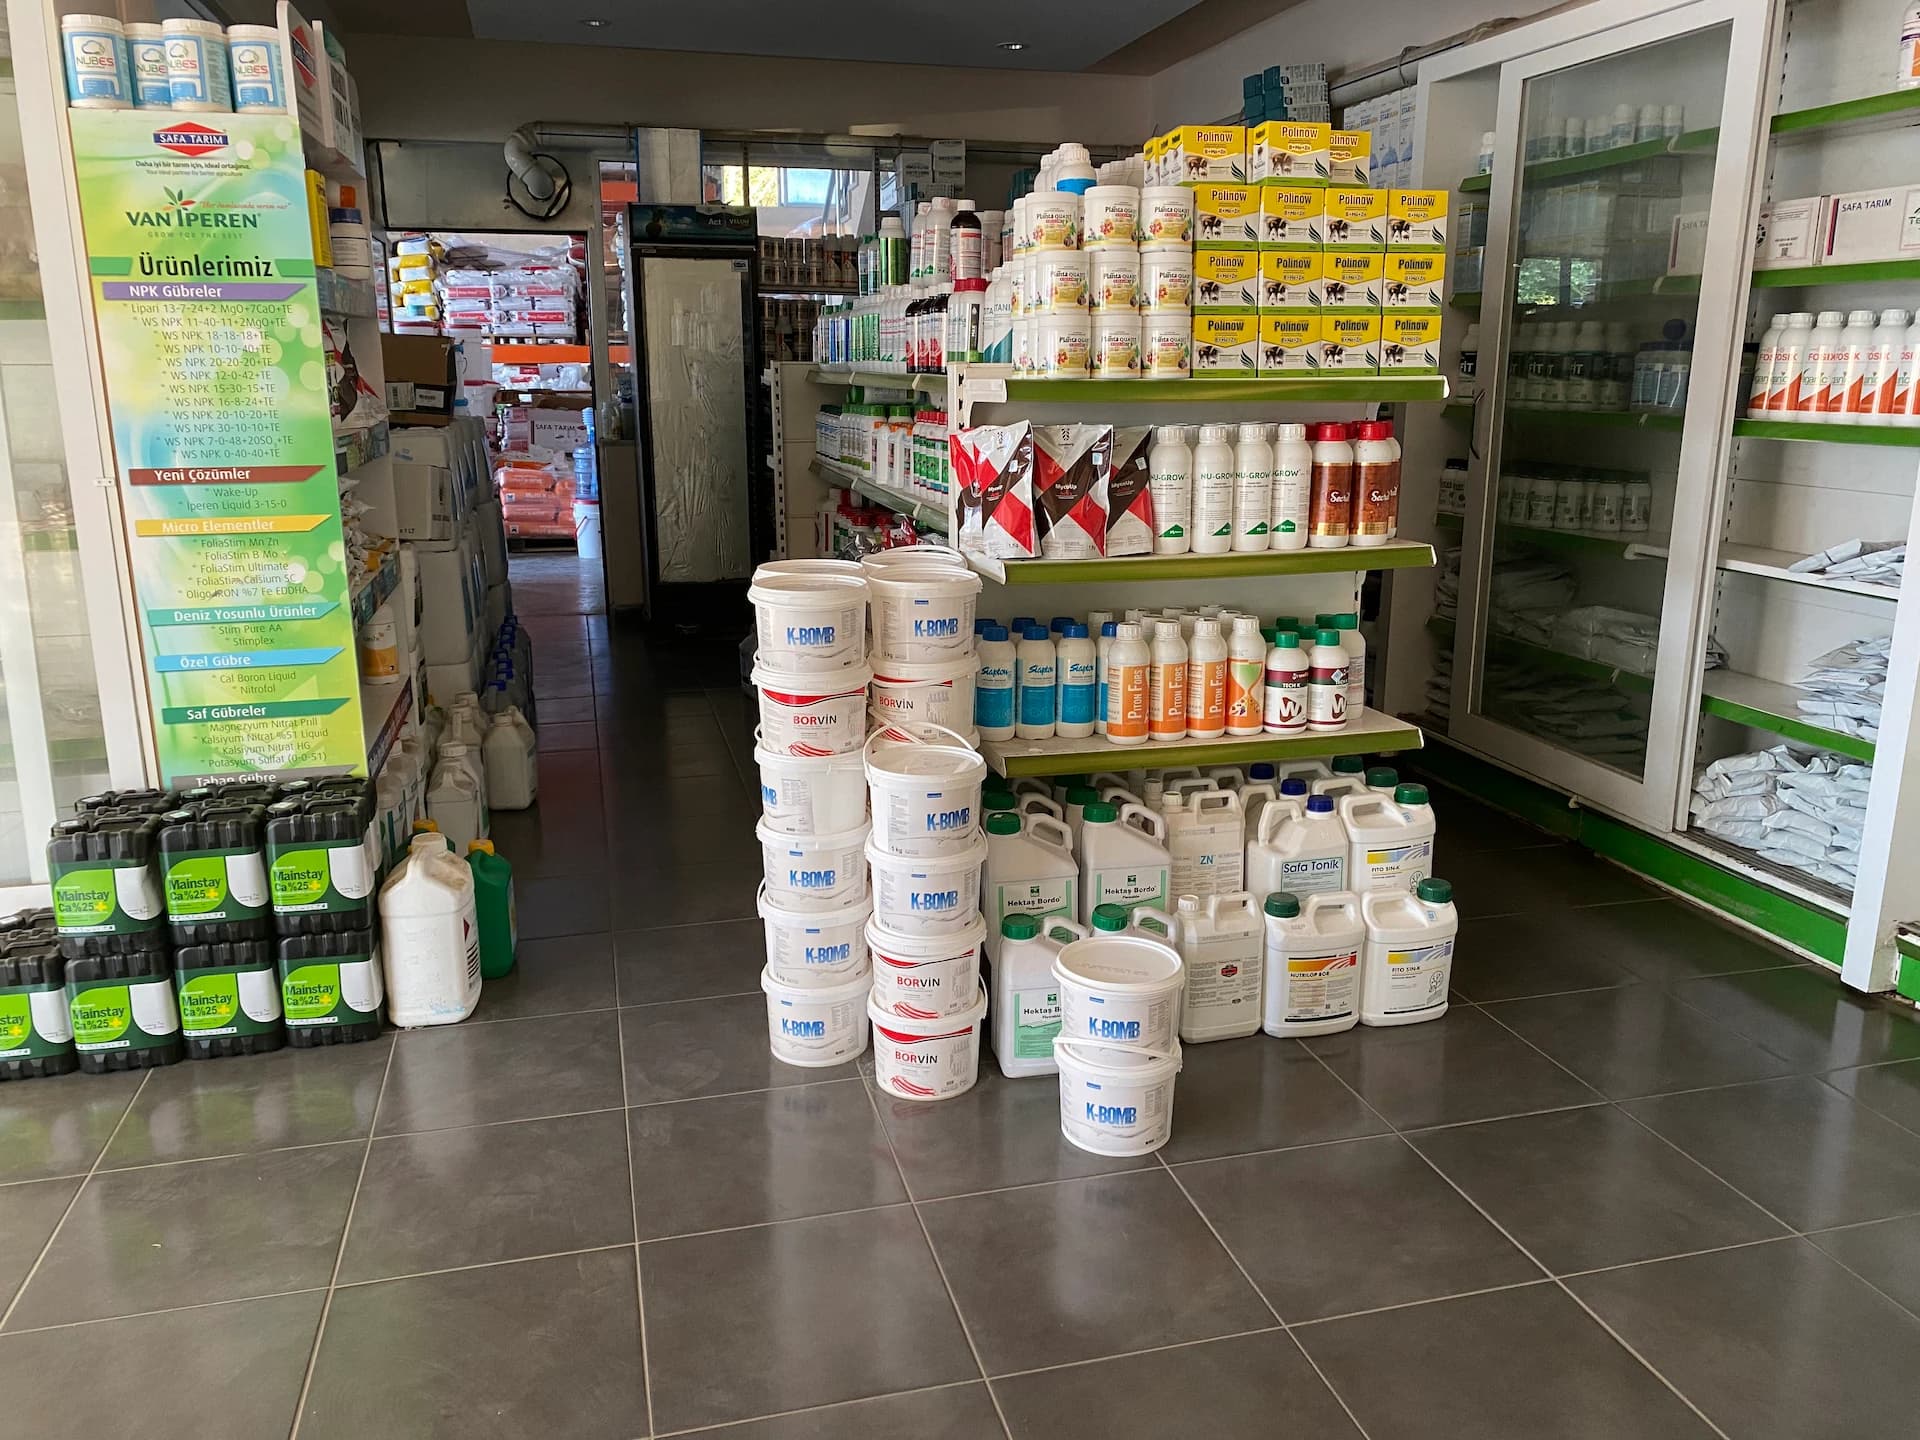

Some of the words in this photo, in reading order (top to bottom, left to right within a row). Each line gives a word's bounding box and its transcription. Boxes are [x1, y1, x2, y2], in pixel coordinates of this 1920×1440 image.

[76, 56, 114, 66] NUBES
[1196, 131, 1234, 143] Polinow
[1280, 126, 1319, 139] Polinow
[159, 134, 186, 144] SAFA
[190, 135, 223, 144] TARIM
[1211, 189, 1247, 201] Polinow
[1277, 192, 1312, 204] Polinow
[1338, 194, 1374, 206] Polinow
[1401, 195, 1435, 207] Polinow
[1841, 202, 1862, 213] SAFA
[1865, 198, 1892, 209] TARIM
[126, 212, 170, 227] VAN
[139, 252, 272, 277] Ürünlerimiz
[1209, 256, 1244, 268] Polinow
[1276, 257, 1311, 269] Polinow
[1336, 257, 1370, 268] Polinow
[1398, 259, 1433, 270] Polinow
[129, 286, 158, 297] NPK
[162, 285, 222, 298] Gübreler
[131, 304, 159, 314] Lipari
[164, 304, 216, 313] 13-7-24+2
[142, 318, 158, 327] WS
[162, 318, 182, 327] NPK
[1208, 320, 1244, 331] Polinow
[1274, 321, 1309, 332] Polinow
[1334, 320, 1369, 331] Polinow
[1395, 320, 1429, 331] Polinow
[162, 331, 178, 340] WS
[182, 331, 202, 340] NPK
[208, 331, 269, 340] 18-18-18+TE
[164, 344, 181, 354] WS
[184, 344, 204, 354] NPK
[209, 344, 271, 354] 10-10-40+TE
[166, 358, 182, 367] WS
[185, 358, 206, 367] NPK
[210, 358, 272, 367] 20-20-20+TE
[171, 371, 187, 380] WS
[190, 371, 211, 380] NPK
[215, 371, 271, 380] 12-0-42+TE
[170, 384, 185, 393] WS
[189, 384, 209, 393] NPK
[214, 384, 276, 393] 15-30-15+TE
[175, 398, 191, 406] WS
[194, 398, 215, 406] NPK
[219, 397, 274, 406] 16-8-24+TE
[173, 411, 189, 420] WS
[193, 411, 213, 420] NPK
[216, 410, 278, 420] 20-10-20+TE
[175, 425, 192, 433] WS
[194, 424, 215, 433] NPK
[218, 423, 280, 433] 30-10-10+TE
[164, 438, 180, 446] WS
[184, 437, 204, 446] NPK
[182, 450, 198, 459] WS
[201, 450, 221, 459] NPK
[224, 449, 280, 459] 0-40-40+TE
[154, 469, 184, 481] Yeni
[189, 468, 251, 483] Çözümler
[214, 488, 258, 498] Wake-Up
[222, 500, 251, 510] Liquid
[255, 500, 286, 509] 3-15-0
[163, 522, 197, 533] Micro
[203, 520, 274, 532] Elementler
[201, 539, 246, 547] FoliaStim
[250, 538, 265, 546] Mn
[268, 538, 279, 546] Zn
[205, 551, 249, 560] FoliaStim
[200, 564, 245, 573] FoliaStim
[248, 563, 289, 572] Ultimate
[244, 575, 281, 584] Calsium
[174, 610, 210, 621] Deniz
[214, 608, 266, 620] Yosunlu
[270, 605, 316, 618] Ürünler
[219, 625, 241, 634] Stim
[244, 625, 265, 633] Pure
[269, 624, 282, 632] AA
[914, 618, 959, 636] K-BOMB
[234, 636, 274, 647] Stimplex
[786, 626, 835, 646] K-BOMB
[180, 655, 207, 668] Özel
[213, 654, 250, 667] Gübre
[220, 674, 234, 683] Cal
[238, 673, 265, 682] Boron
[269, 672, 296, 682] Liquid
[240, 684, 276, 694] Nitrofol
[879, 696, 914, 710] BORVİN
[187, 708, 207, 720] Saf
[211, 705, 266, 719] Gübreler
[210, 720, 268, 732] Magnezyum
[271, 719, 297, 728] Nitrat
[793, 714, 837, 725] BORVİN
[201, 734, 244, 745] Kalsiyum
[276, 731, 298, 740] %51
[301, 729, 328, 740] Liquid
[223, 746, 265, 756] Kalsiyum
[268, 743, 294, 753] Nitrat
[297, 742, 310, 750] HG
[208, 757, 255, 768] Potasyum
[239, 774, 276, 785] Gübre
[927, 807, 970, 831] K-BOMB
[1200, 855, 1213, 865] ZN
[1283, 861, 1308, 874] Safa
[1311, 859, 1340, 871] Tonik
[273, 869, 324, 882] Mainstay
[790, 870, 836, 886] K-BOMB
[168, 877, 221, 890] Mainstay
[58, 889, 110, 902] Mainstay
[911, 891, 958, 910] K-BOMB
[805, 943, 850, 964] K-BOMB
[897, 972, 940, 987] BORVİN
[285, 983, 335, 996] Mainstay
[181, 993, 232, 1007] Mainstay
[72, 1006, 125, 1020] Mainstay
[781, 1017, 824, 1037] K-BOMB
[1088, 1016, 1140, 1040] K-BOMB
[895, 1050, 938, 1064] BORVİN
[1086, 1102, 1137, 1125] K-BOMB
